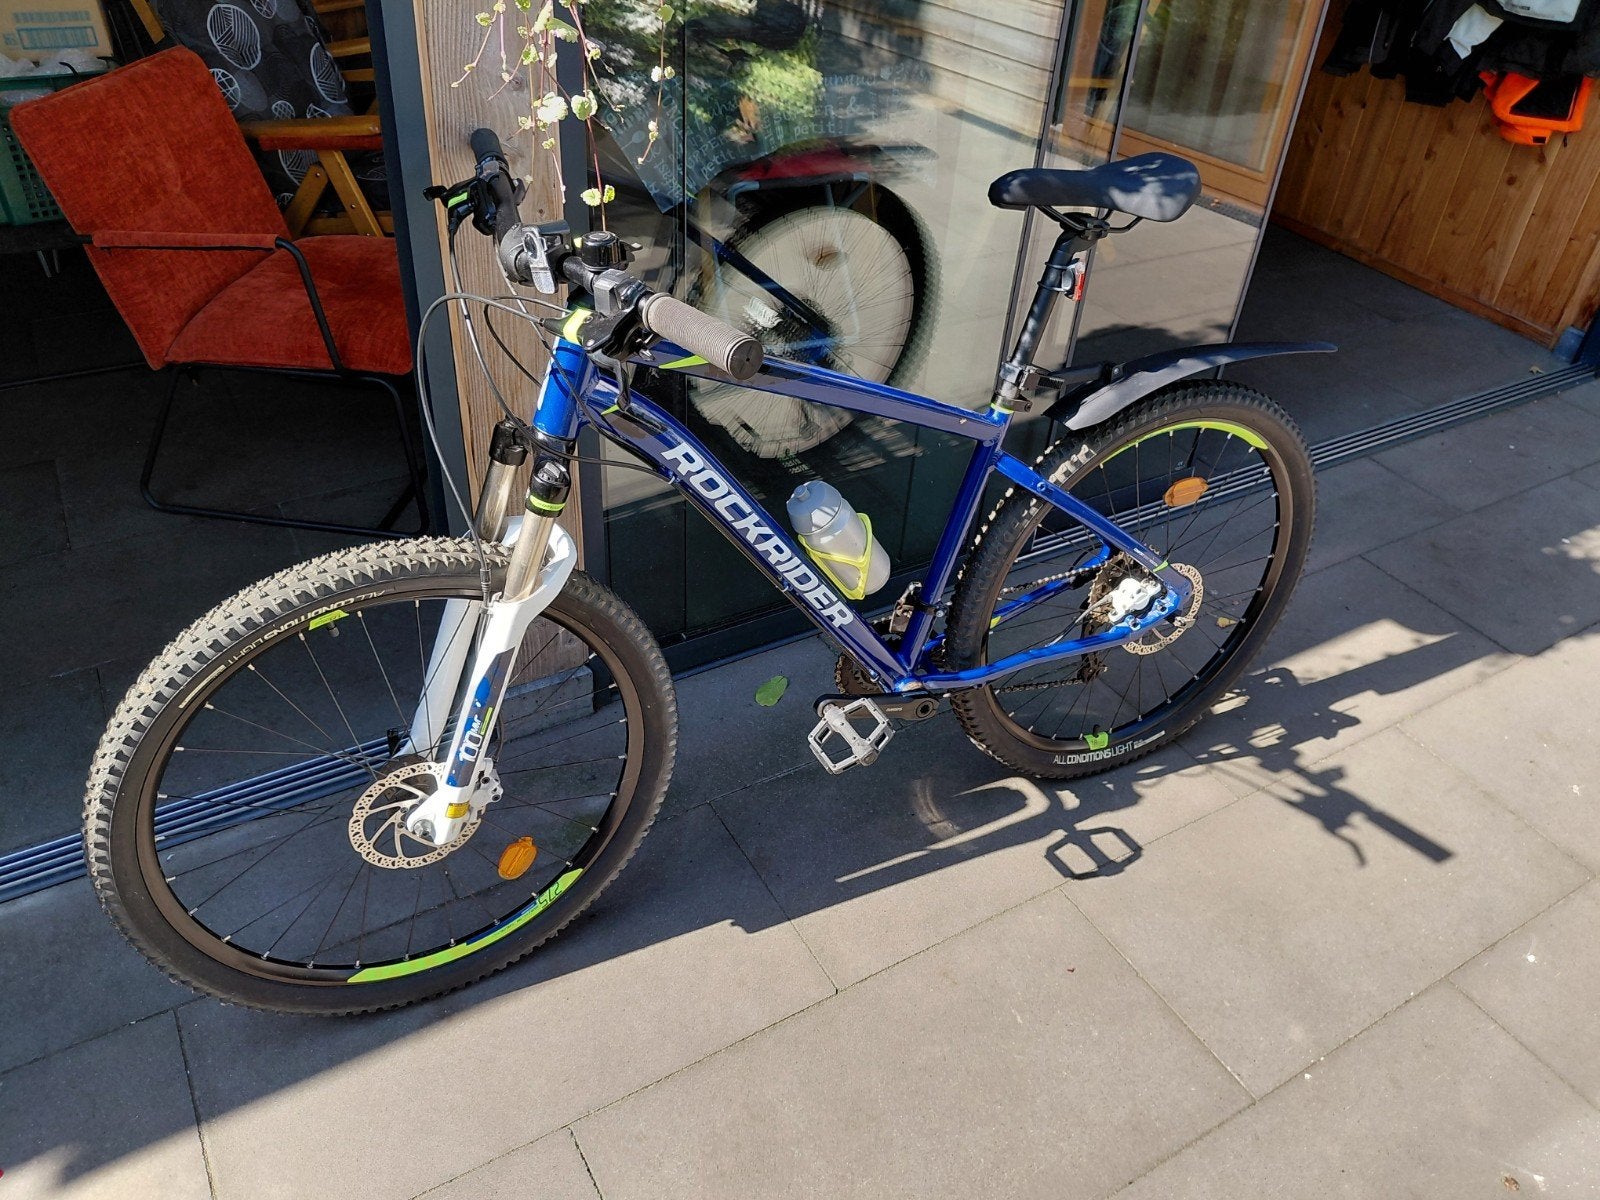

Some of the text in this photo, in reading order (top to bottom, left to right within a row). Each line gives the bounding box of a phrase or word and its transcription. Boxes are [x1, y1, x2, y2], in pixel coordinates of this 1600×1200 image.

[661, 442, 854, 628] ROCKRIDER
[263, 597, 355, 641] CONDITIONS
[228, 637, 265, 667] LIGHT
[1053, 754, 1067, 765] ALL
[1066, 749, 1113, 765] CONDITIONS
[1111, 740, 1134, 758] LIGHT
